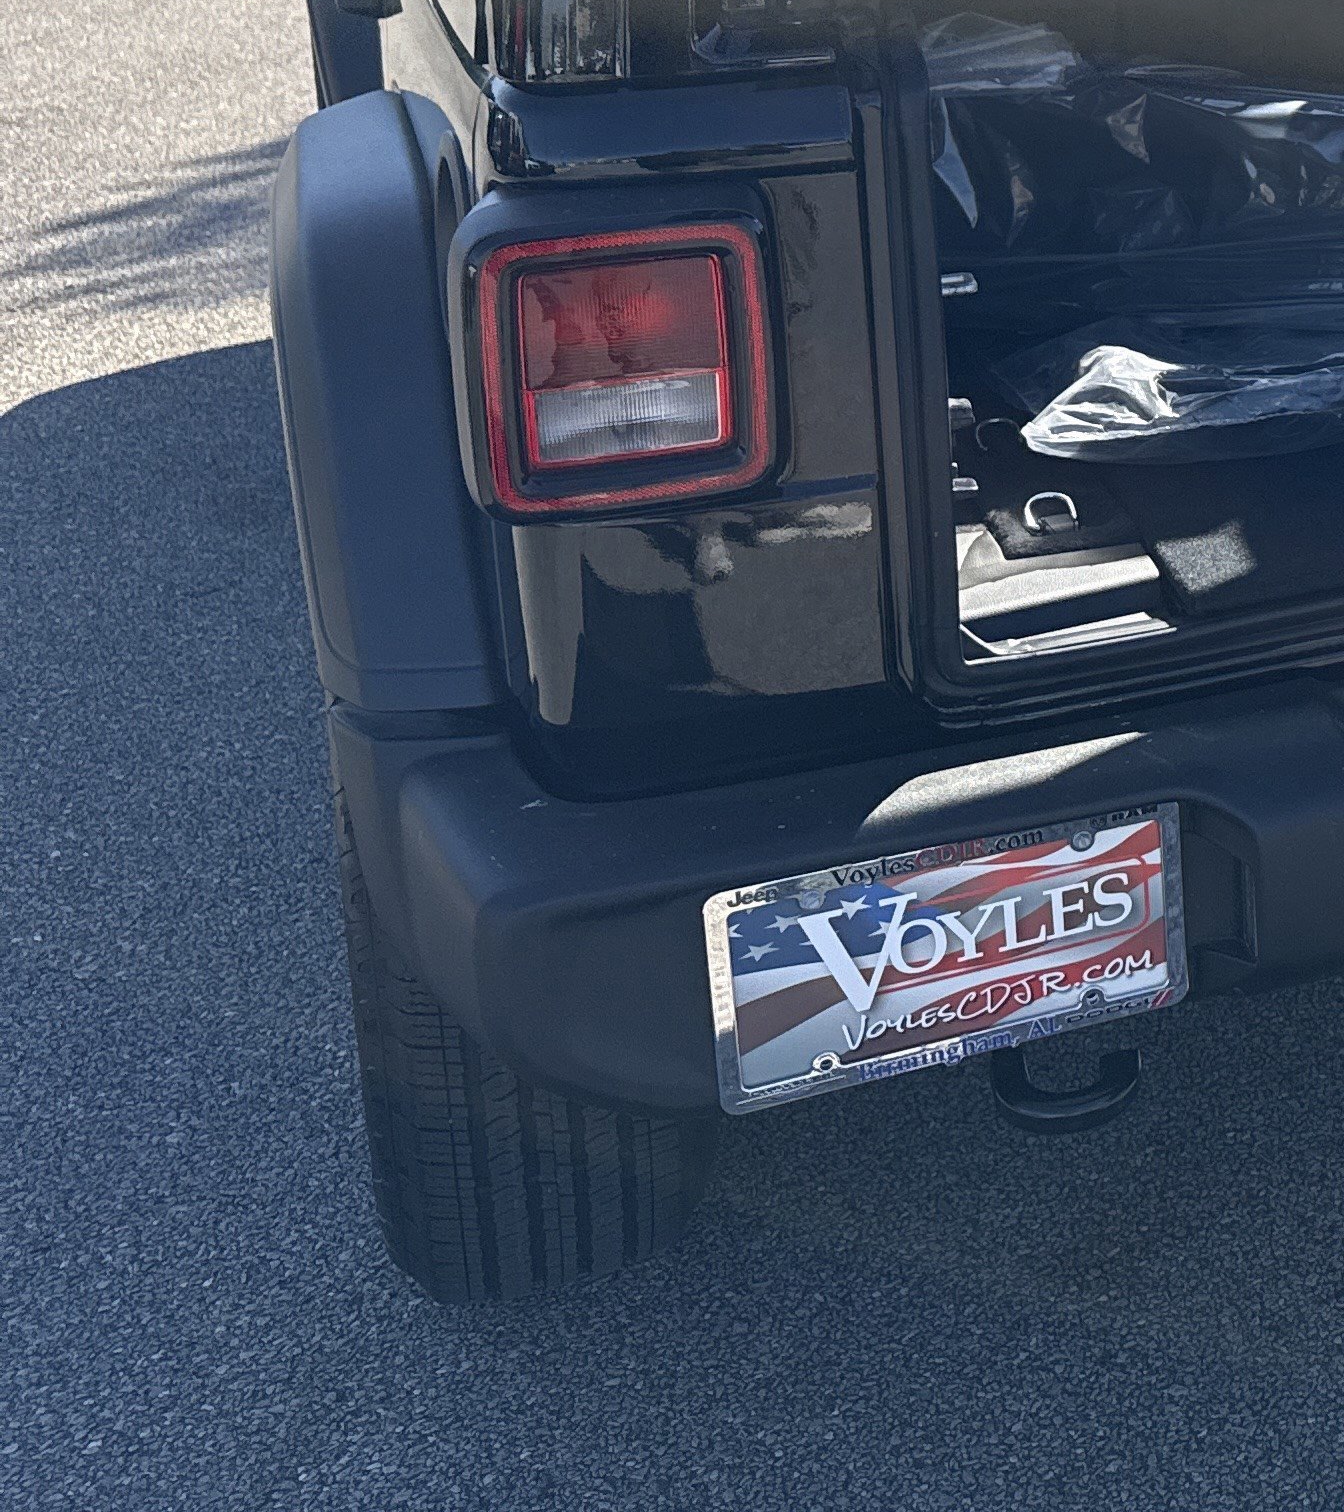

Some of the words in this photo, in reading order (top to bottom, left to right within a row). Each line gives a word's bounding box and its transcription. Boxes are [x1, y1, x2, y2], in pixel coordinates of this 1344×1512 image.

[832, 827, 1043, 888] VoylesCDJR.com
[727, 886, 780, 908] Jeep
[797, 872, 1136, 1014] VOYLES
[1027, 1017, 1064, 1038] AL
